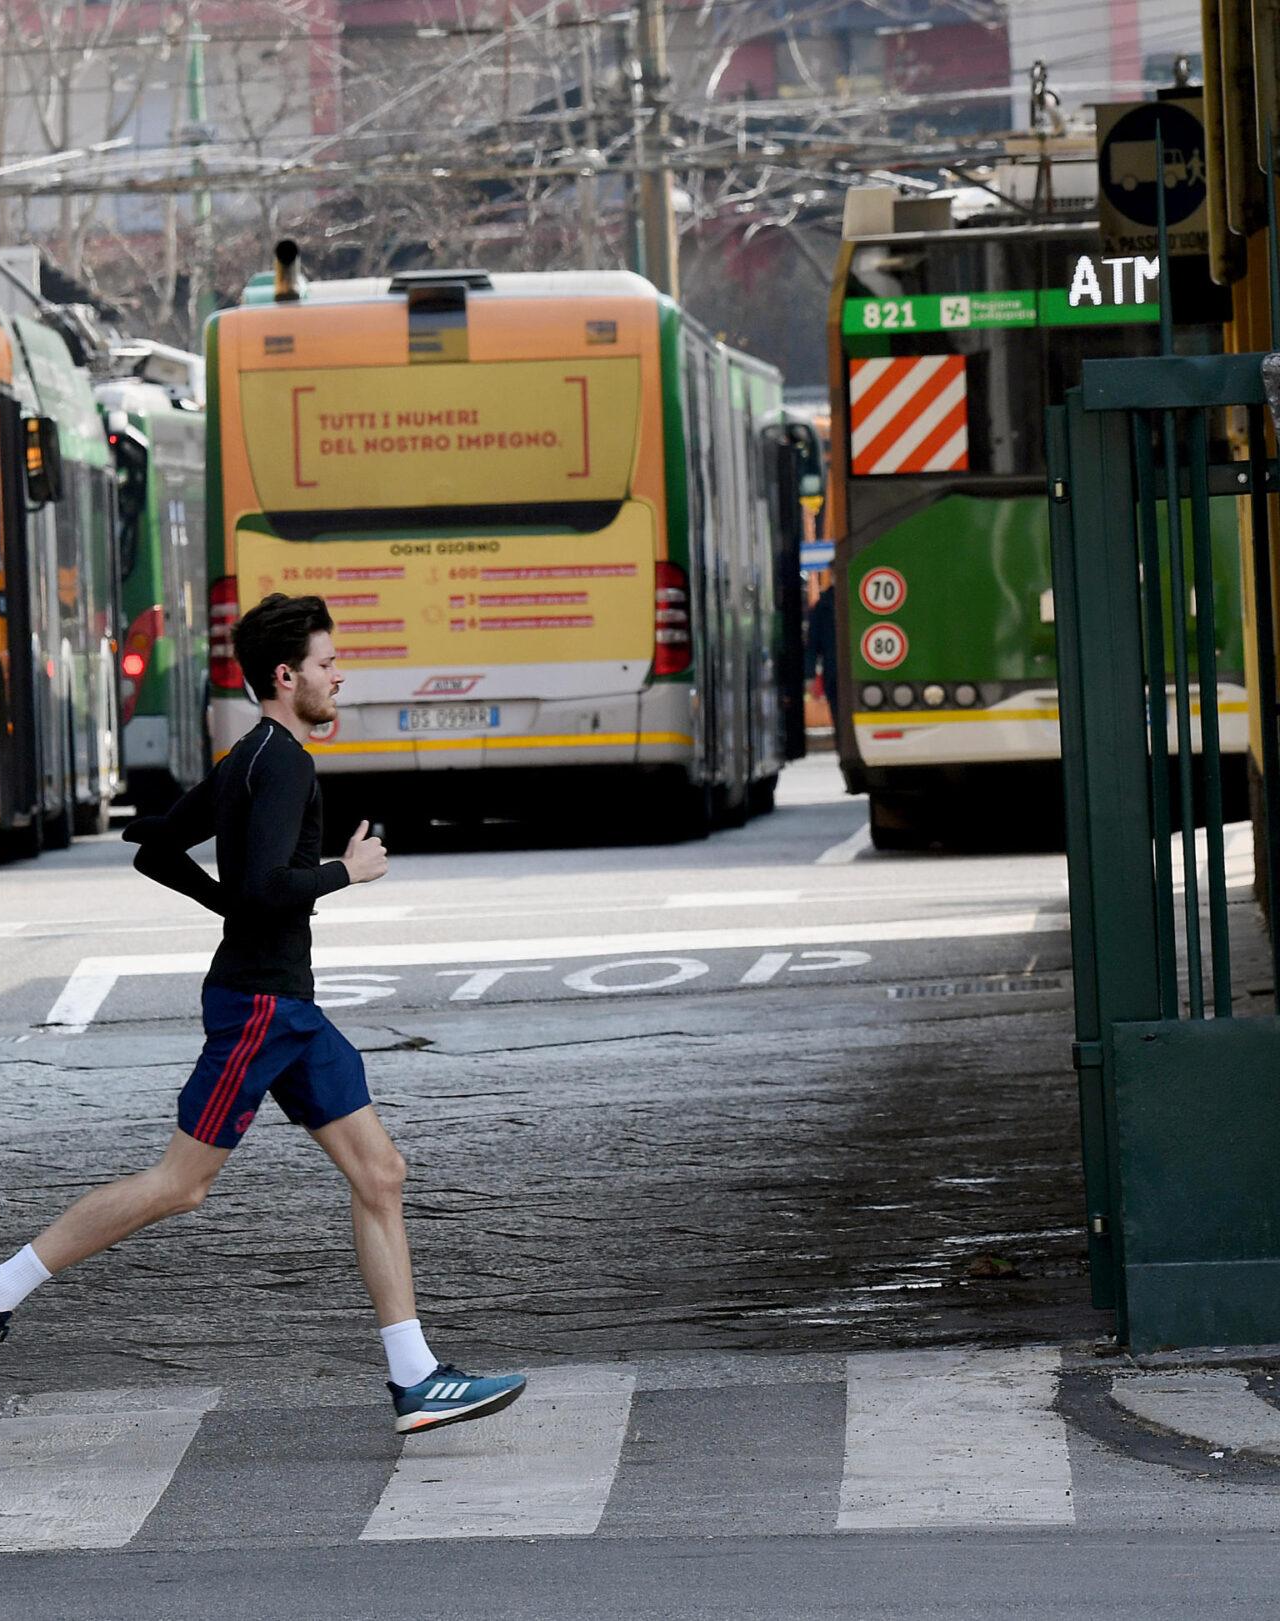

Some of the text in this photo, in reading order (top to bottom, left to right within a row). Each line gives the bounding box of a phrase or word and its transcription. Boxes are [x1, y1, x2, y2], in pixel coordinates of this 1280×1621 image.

[1069, 255, 1160, 307] ATM
[863, 301, 916, 328] 821
[319, 409, 479, 430] TUTTI I NUMERI
[320, 430, 562, 455] DEL NOSTRO IMPEGNO.
[390, 541, 501, 556] OGNI GIORNO
[871, 580, 895, 601] 70
[874, 637, 895, 655] 80
[312, 949, 873, 1009] STOP
